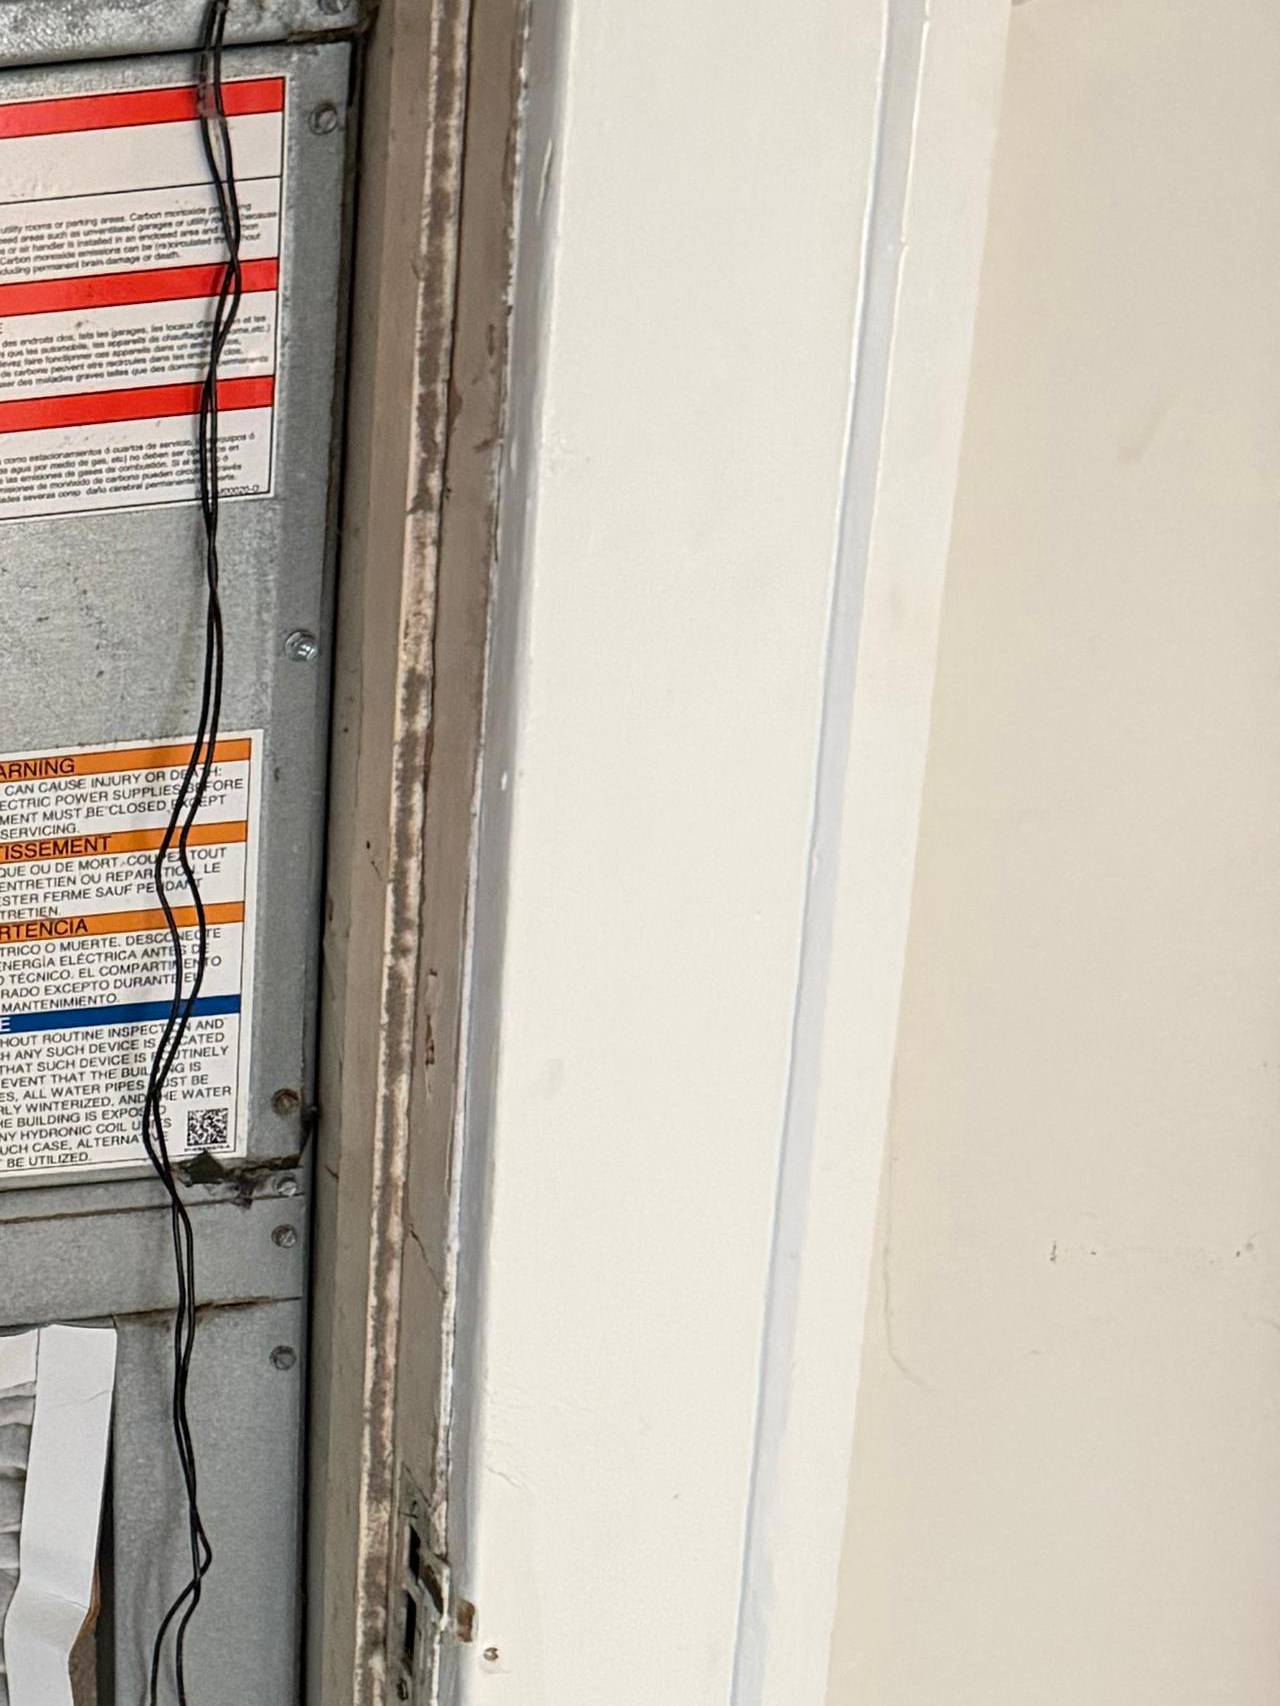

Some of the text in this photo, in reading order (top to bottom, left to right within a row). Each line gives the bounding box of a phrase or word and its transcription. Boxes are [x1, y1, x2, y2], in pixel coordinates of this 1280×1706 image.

[3, 783, 35, 797] CAN
[37, 777, 86, 793] CAUSE
[90, 772, 141, 788] INJURY
[143, 769, 166, 784] OR
[0, 821, 77, 840] SERVICING.
[28, 863, 51, 876] OU
[54, 860, 74, 873] DE
[43, 941, 56, 954] O
[0, 991, 117, 1013] MANTENIMIENTO.
[41, 1028, 104, 1044] ROUTINE
[22, 1088, 47, 1100] ALL
[49, 1083, 101, 1098] WATER
[104, 1078, 145, 1093] PIPES
[5, 1156, 25, 1168] BE
[27, 1150, 89, 1167] UTILIZED.
